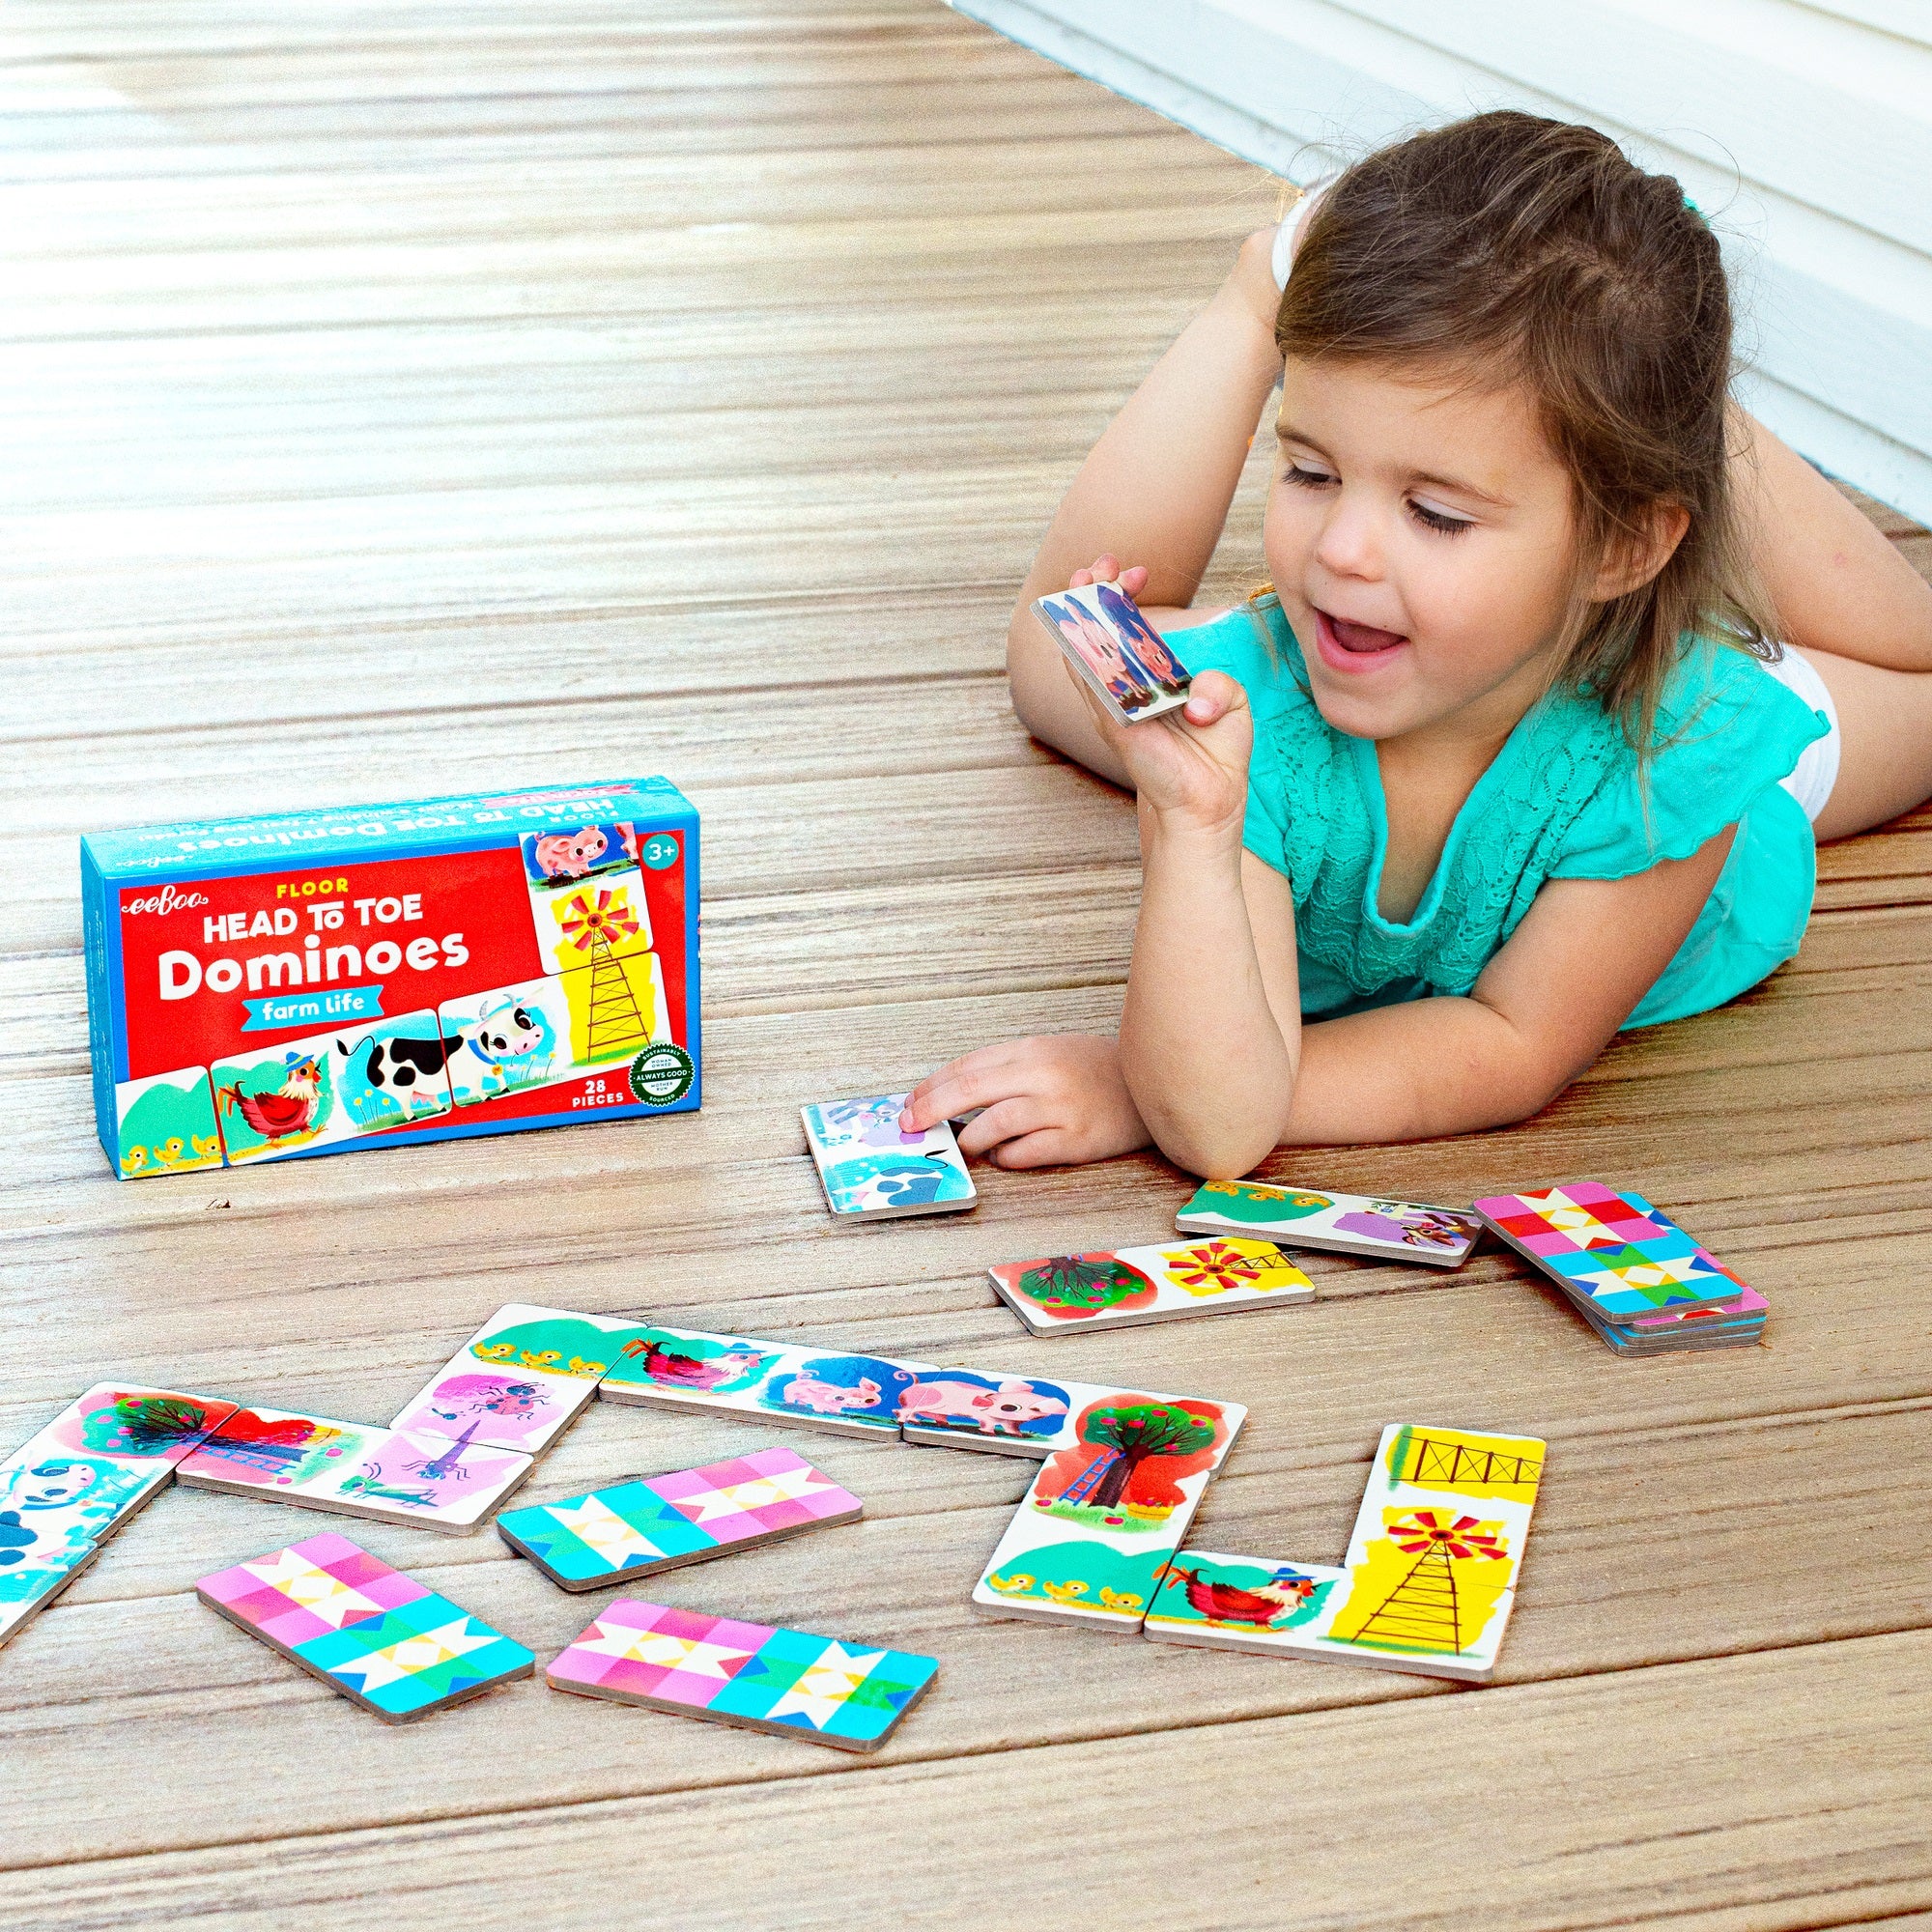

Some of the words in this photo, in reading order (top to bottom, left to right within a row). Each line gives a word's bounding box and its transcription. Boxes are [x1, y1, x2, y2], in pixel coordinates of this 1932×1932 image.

[520, 798, 615, 818] HEAD
[391, 813, 466, 832] TOE
[176, 821, 388, 853] Dominoes
[648, 842, 675, 862] 3+
[276, 878, 349, 899] FLOOR
[203, 908, 298, 944] HEAD
[354, 894, 424, 927] TOE
[158, 933, 469, 1001] Dominoes
[262, 999, 321, 1022] farm
[327, 992, 365, 1014] life
[642, 1048, 681, 1061] SUSTAINABLY
[636, 1071, 667, 1081] ALWAYS
[667, 1069, 688, 1078] GOOD
[584, 1080, 606, 1094] 28
[572, 1092, 624, 1108] PIECES
[648, 1094, 675, 1103] SOURCED
